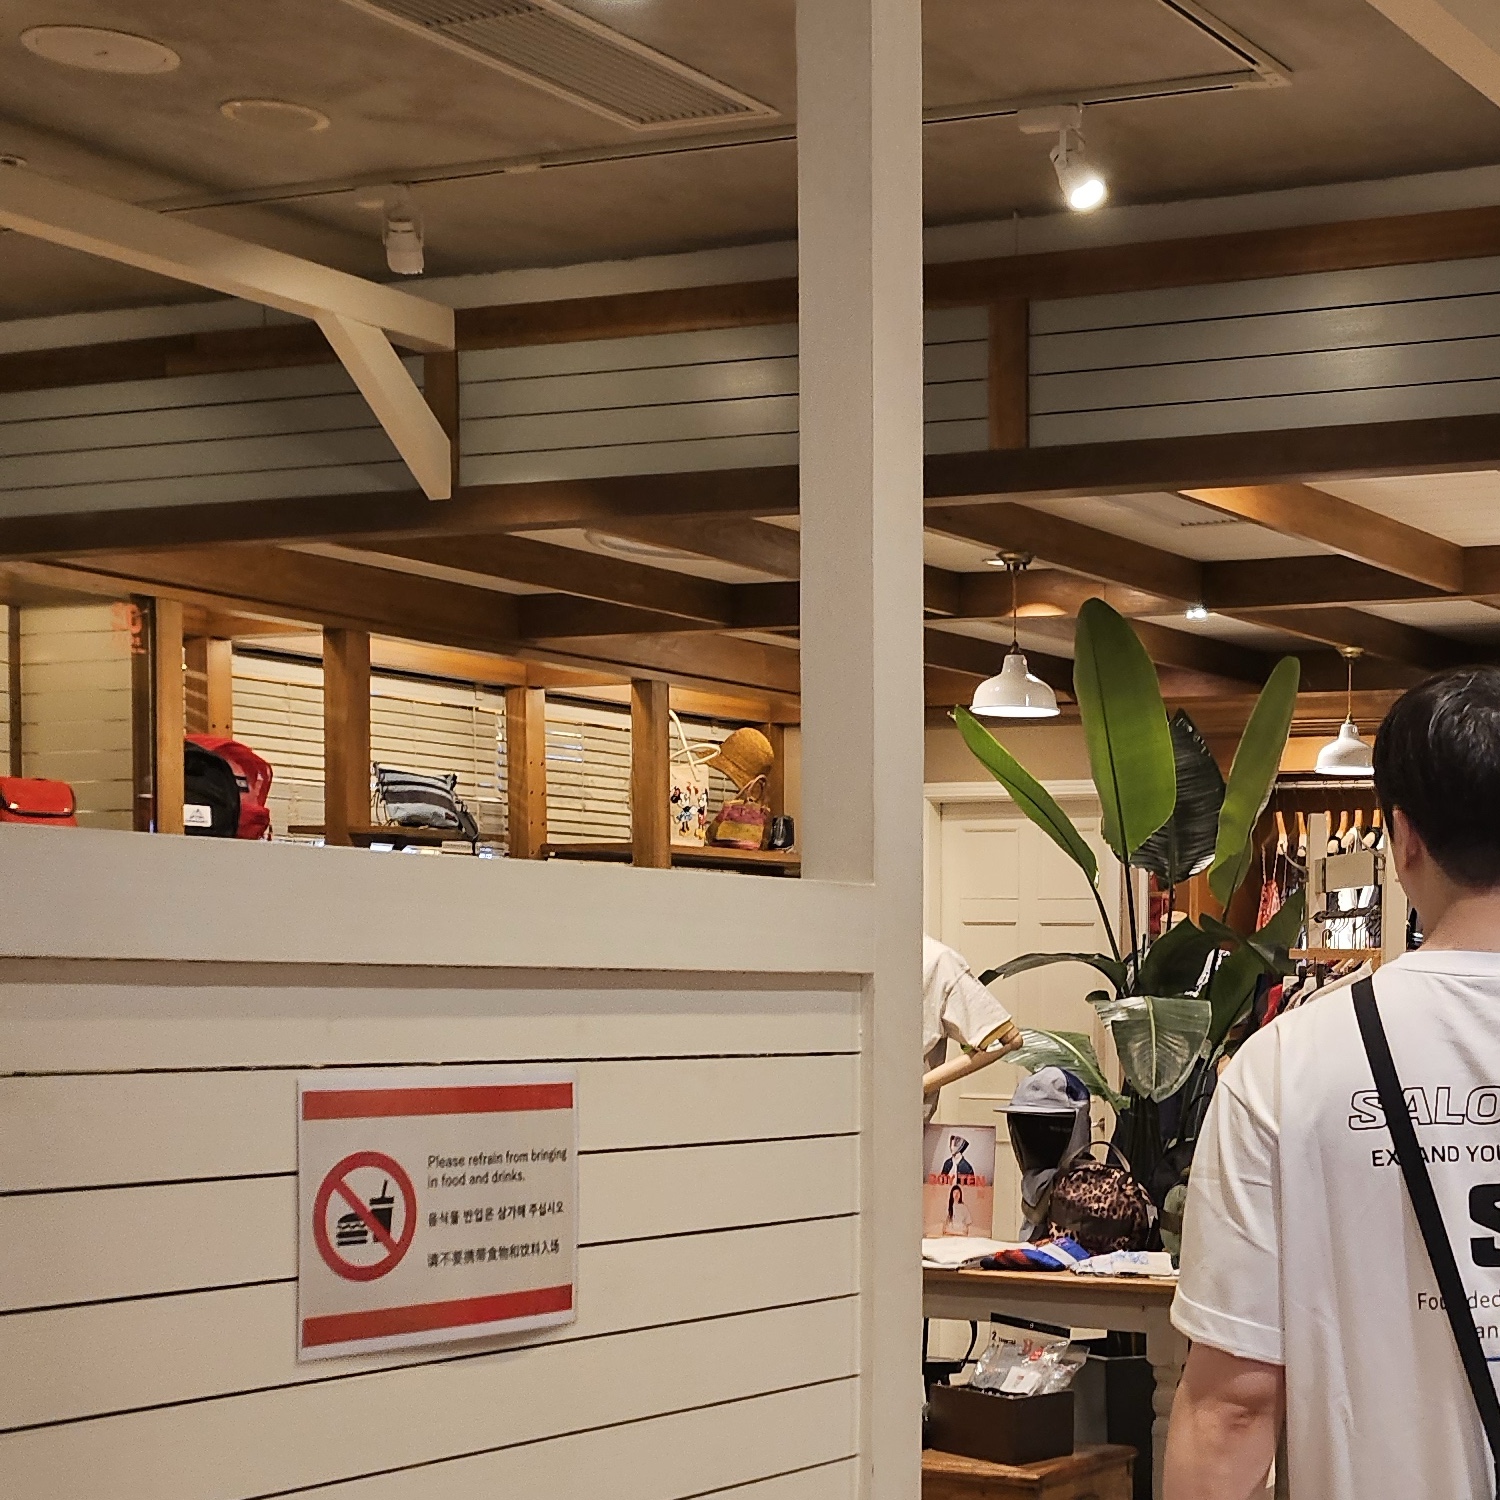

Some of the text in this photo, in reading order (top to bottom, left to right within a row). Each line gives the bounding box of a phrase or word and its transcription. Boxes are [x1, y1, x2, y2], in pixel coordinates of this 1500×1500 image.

[428, 1147, 567, 1169] Please refrain from bringing
[1372, 1145, 1460, 1167] EXAND
[427, 1168, 526, 1189] in food and drinks.
